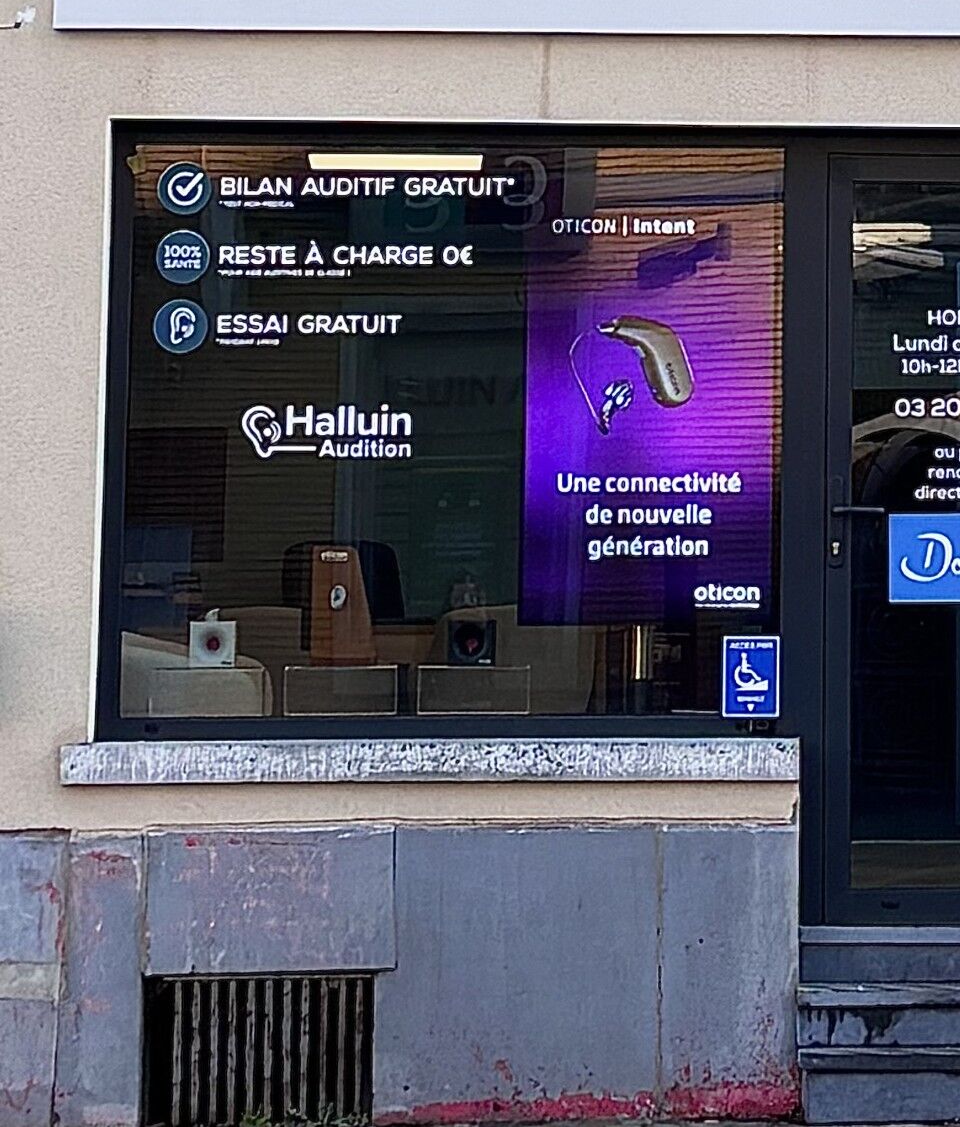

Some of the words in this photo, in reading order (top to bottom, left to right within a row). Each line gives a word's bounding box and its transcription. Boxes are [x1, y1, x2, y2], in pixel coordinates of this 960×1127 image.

[220, 176, 292, 196] BILAN
[300, 176, 396, 196] AUDITIF
[552, 218, 617, 235] OTICON
[633, 217, 696, 236] Intent
[164, 244, 202, 258] 100%
[218, 245, 296, 265] RESTE
[304, 239, 324, 265] À
[333, 245, 434, 265] CHARGE
[216, 314, 288, 334] ESSAI
[297, 314, 403, 334] GRATUIT
[893, 333, 948, 352] Lundi
[894, 398, 926, 417] 03
[285, 403, 412, 436] Halluin
[318, 438, 412, 458] Audition
[934, 447, 955, 459] ou
[557, 473, 601, 493] Une
[605, 471, 742, 493] connectivité
[585, 503, 613, 525] de
[617, 503, 712, 525] nouvelle
[588, 535, 709, 561] génération
[693, 583, 761, 603] oticon
